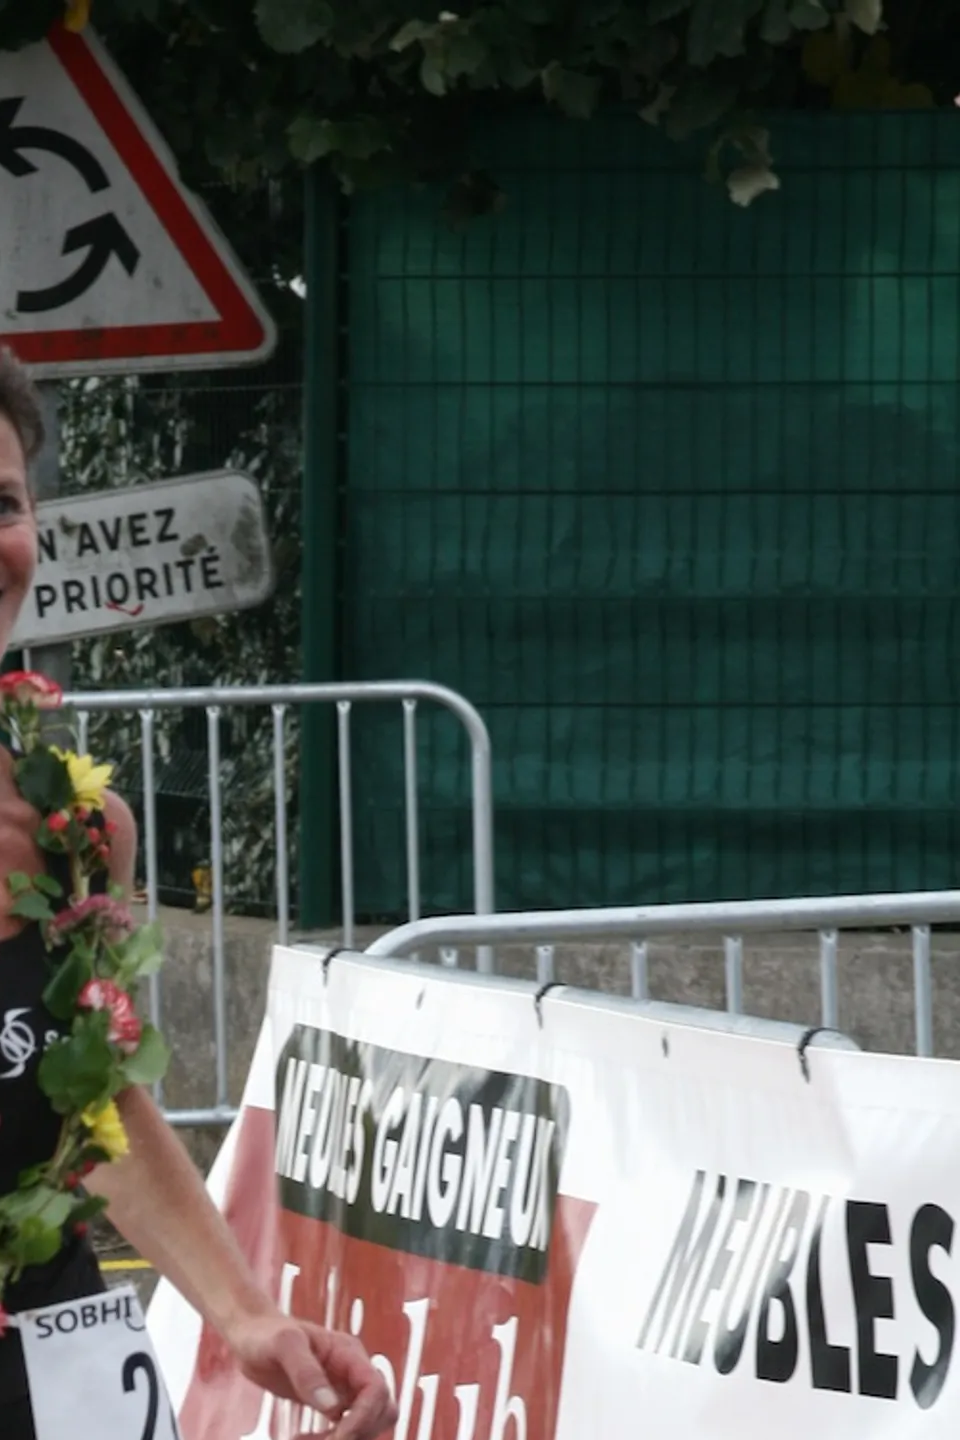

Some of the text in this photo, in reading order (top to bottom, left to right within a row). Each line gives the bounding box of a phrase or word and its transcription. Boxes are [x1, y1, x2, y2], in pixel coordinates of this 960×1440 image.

[34, 546, 224, 618] PRIORITÉ
[35, 1296, 134, 1340] SOBHI
[636, 1169, 956, 1410] MEUBLES
